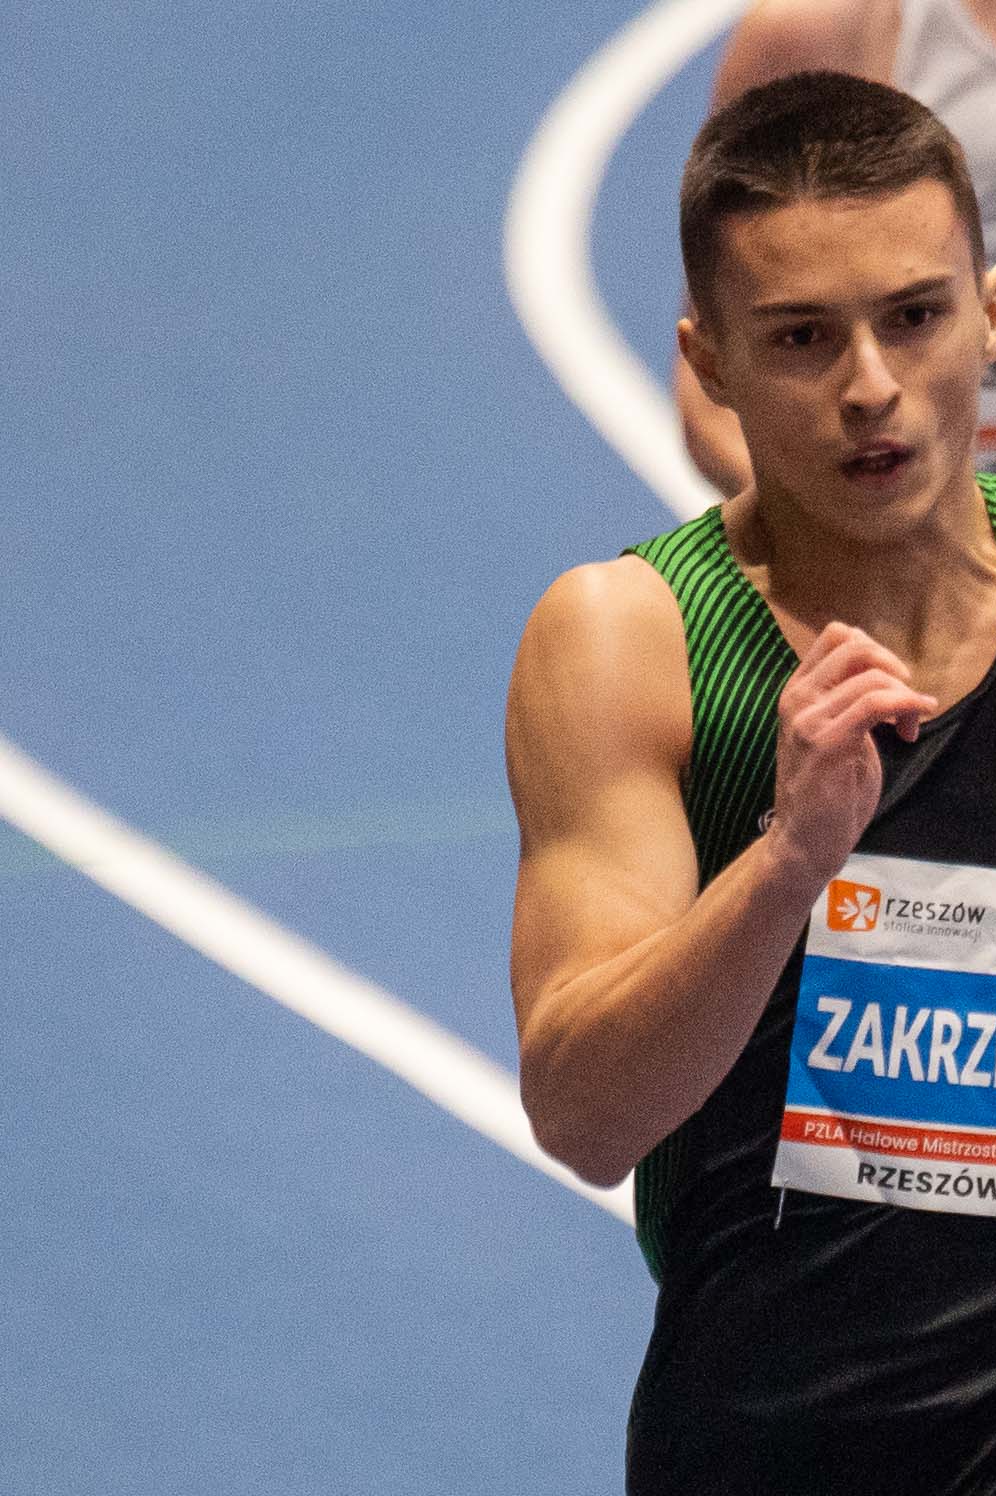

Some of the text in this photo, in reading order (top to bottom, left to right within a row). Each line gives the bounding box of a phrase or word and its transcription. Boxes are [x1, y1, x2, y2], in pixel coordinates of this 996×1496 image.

[885, 898, 986, 924] rzeszów
[883, 920, 982, 943] stolica innowacji
[804, 1121, 845, 1141] PZLA
[850, 1128, 918, 1152] Halowe
